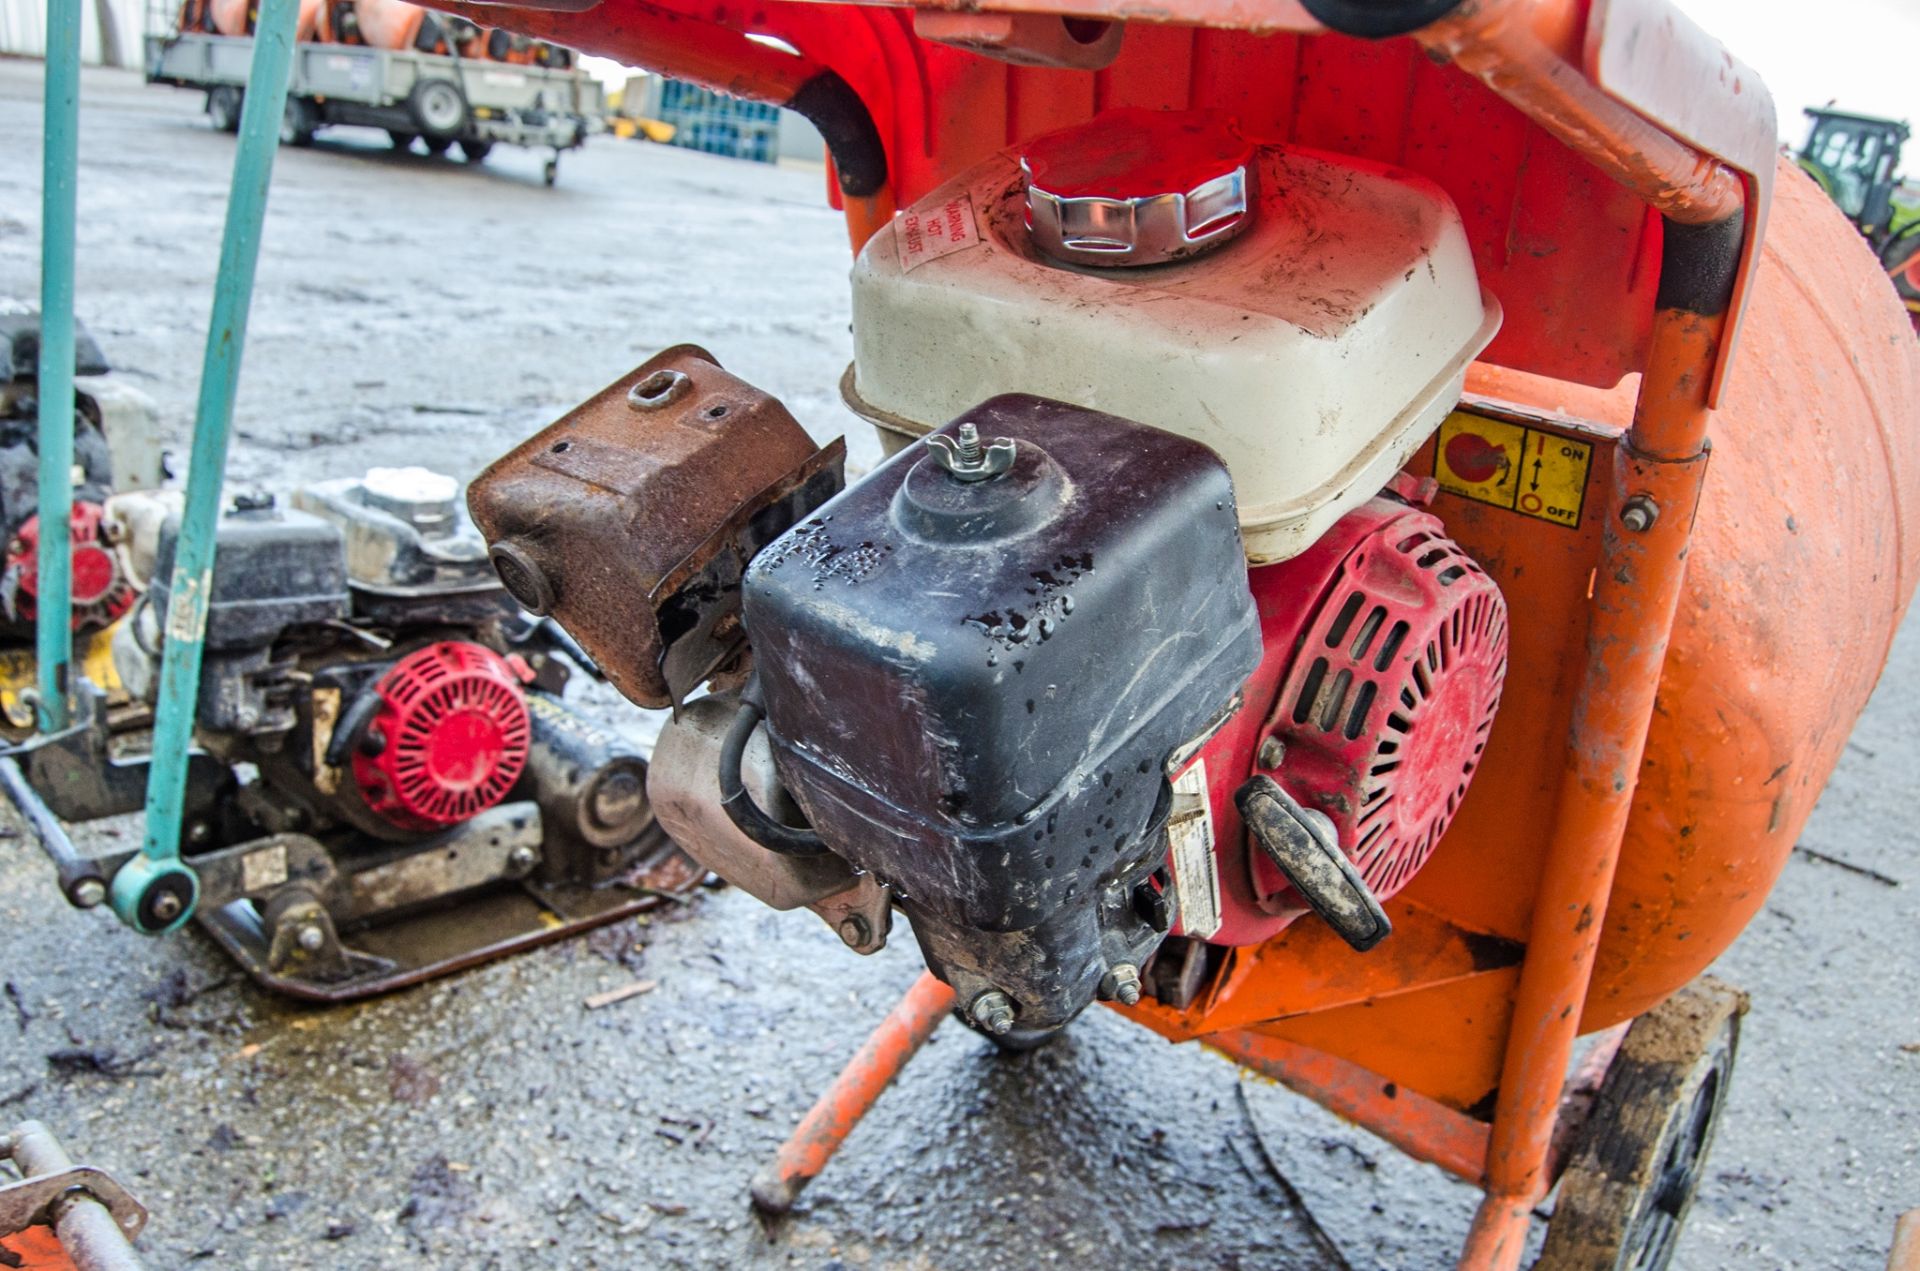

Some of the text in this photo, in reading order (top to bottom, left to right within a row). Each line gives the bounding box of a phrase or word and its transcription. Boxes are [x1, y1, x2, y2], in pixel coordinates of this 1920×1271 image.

[926, 217, 943, 237] HOT
[945, 200, 966, 242] WARNING
[904, 216, 923, 254] EXHAUST
[1560, 447, 1585, 461] ON
[1546, 505, 1576, 520] OFF
